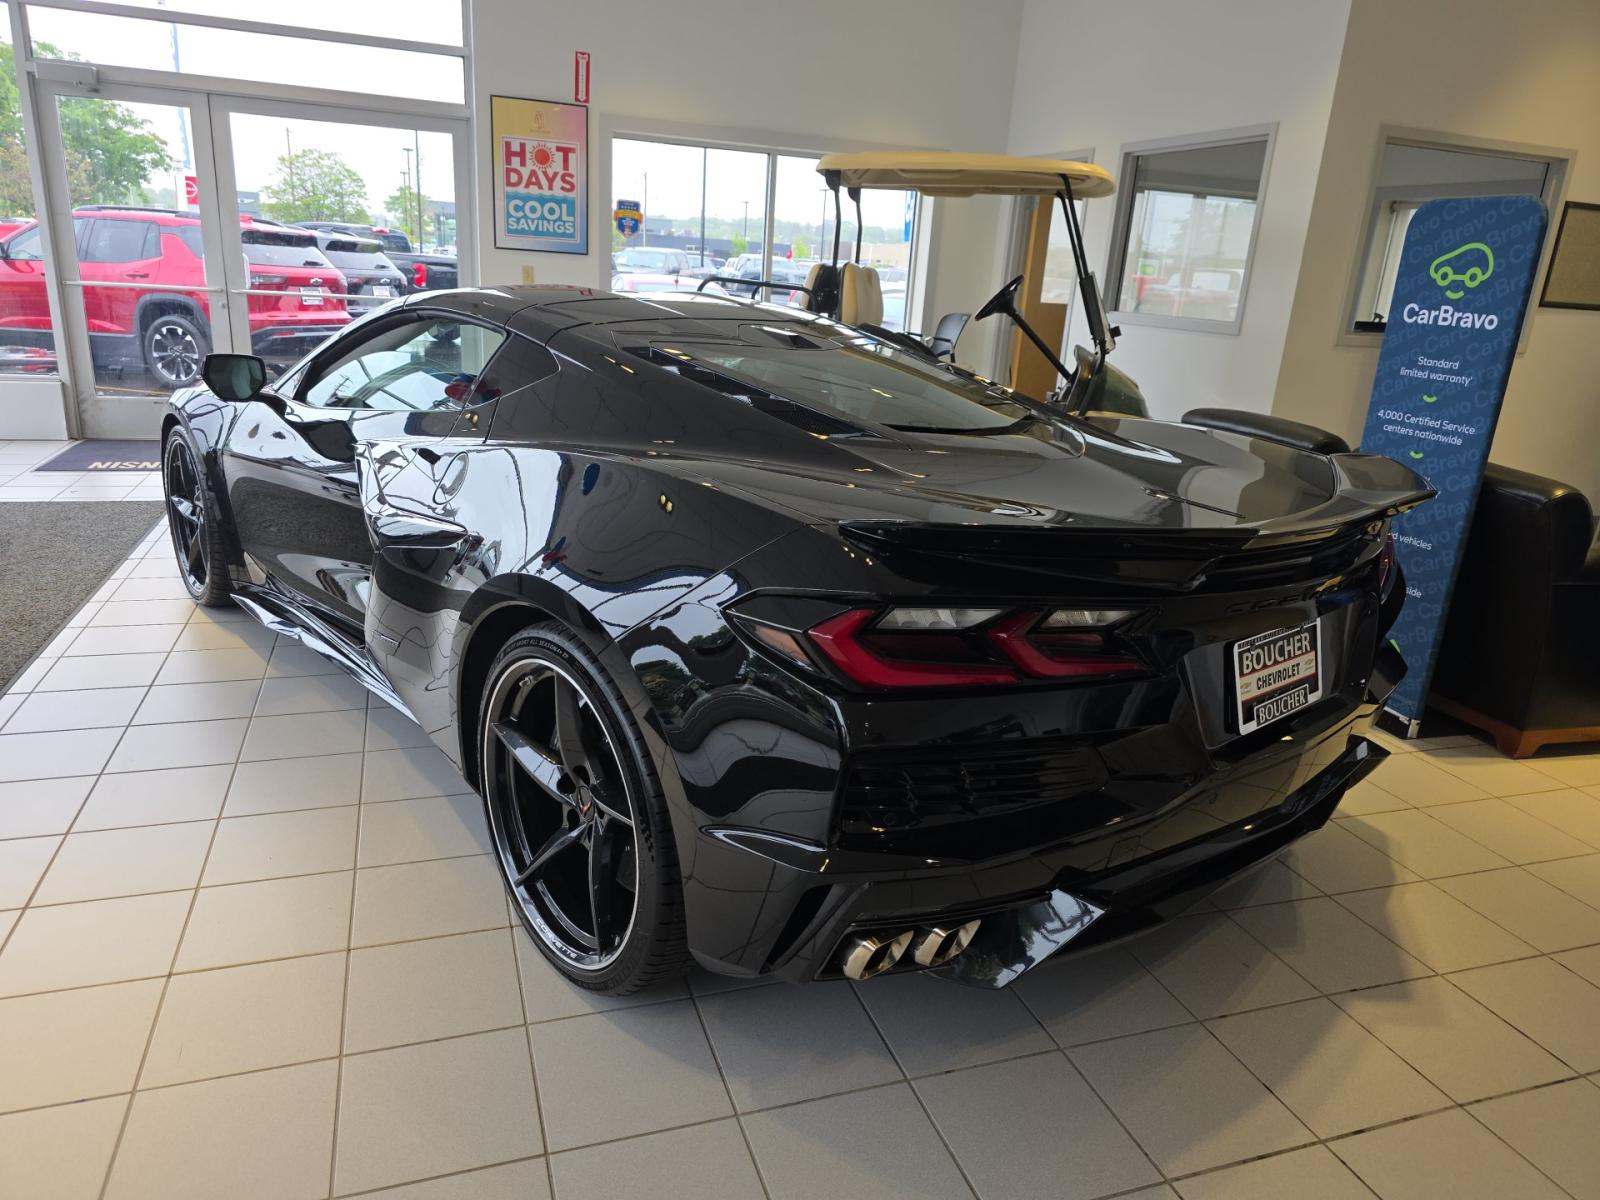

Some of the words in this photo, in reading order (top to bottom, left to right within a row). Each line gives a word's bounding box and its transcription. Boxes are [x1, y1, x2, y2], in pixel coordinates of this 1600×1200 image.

[505, 166, 576, 193] DAYS
[508, 199, 575, 222] COOL
[507, 217, 575, 234] SAVINGS
[1403, 303, 1498, 331] CarBravo
[1400, 367, 1428, 379] limited
[1418, 356, 1460, 370] Standard
[1378, 409, 1403, 421] 4,000
[1404, 413, 1441, 429] Certified
[1442, 420, 1476, 435] Service
[1383, 424, 1414, 436] centers
[1414, 430, 1463, 446] nationwide
[1399, 535, 1432, 551] vehicles
[1242, 632, 1311, 674] BOUCHER
[1256, 662, 1301, 690] CHEVROLET
[1259, 689, 1305, 723] BOUCHER
